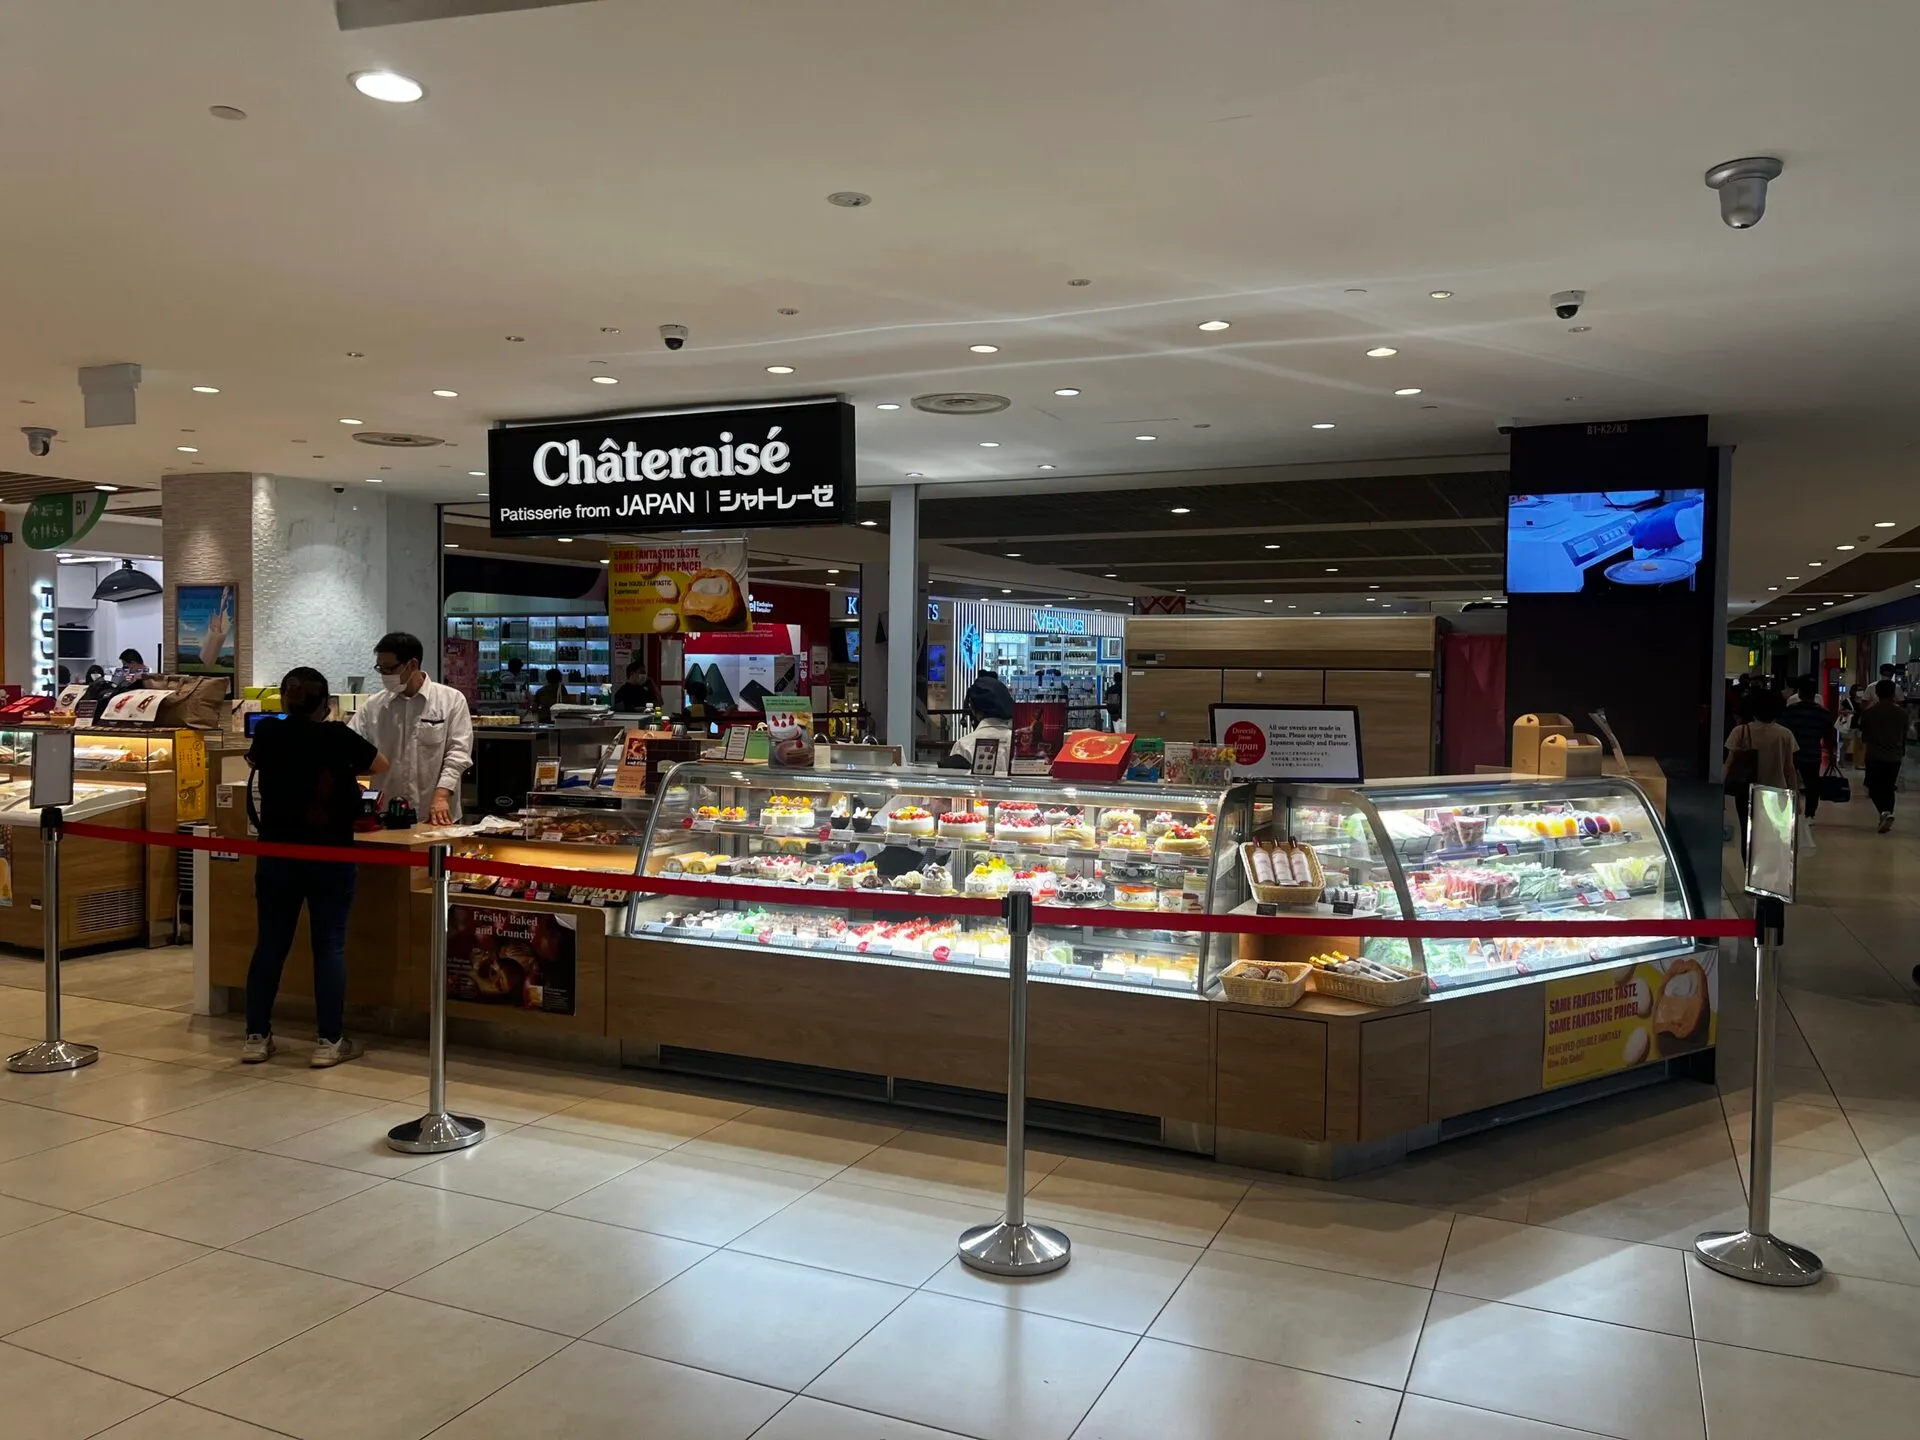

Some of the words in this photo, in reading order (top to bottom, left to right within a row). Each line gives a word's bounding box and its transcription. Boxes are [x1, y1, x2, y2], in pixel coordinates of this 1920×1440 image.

[1588, 424, 1627, 434] B1-K2/K3
[533, 426, 790, 487] Châteraisé
[719, 485, 834, 512] シャトレーゼ
[76, 502, 86, 516] B1
[501, 506, 572, 522] Patisserie
[576, 504, 610, 519] from
[616, 491, 695, 516] JAPAN
[614, 550, 634, 561] SAME
[636, 549, 675, 560] FANTASTIC
[614, 563, 633, 573] SAME
[636, 562, 675, 572] FANTASTIC
[677, 561, 701, 572] PRICE!
[848, 597, 858, 614] K
[1033, 612, 1085, 634] VENUS
[1232, 727, 1256, 736] Directly
[1234, 741, 1258, 752] Japan
[1269, 740, 1294, 748] Japanese
[1296, 740, 1316, 748] quality
[474, 911, 506, 924] Freshly
[510, 915, 538, 926] Baked
[476, 926, 492, 936] and
[496, 927, 536, 942] Crunchy
[1550, 997, 1571, 1014] SAME
[1573, 988, 1614, 1010] FANTASTIC
[1549, 1017, 1570, 1035] SAME
[1572, 1008, 1613, 1030] FANTASTIC
[1615, 1002, 1638, 1020] PRICE!
